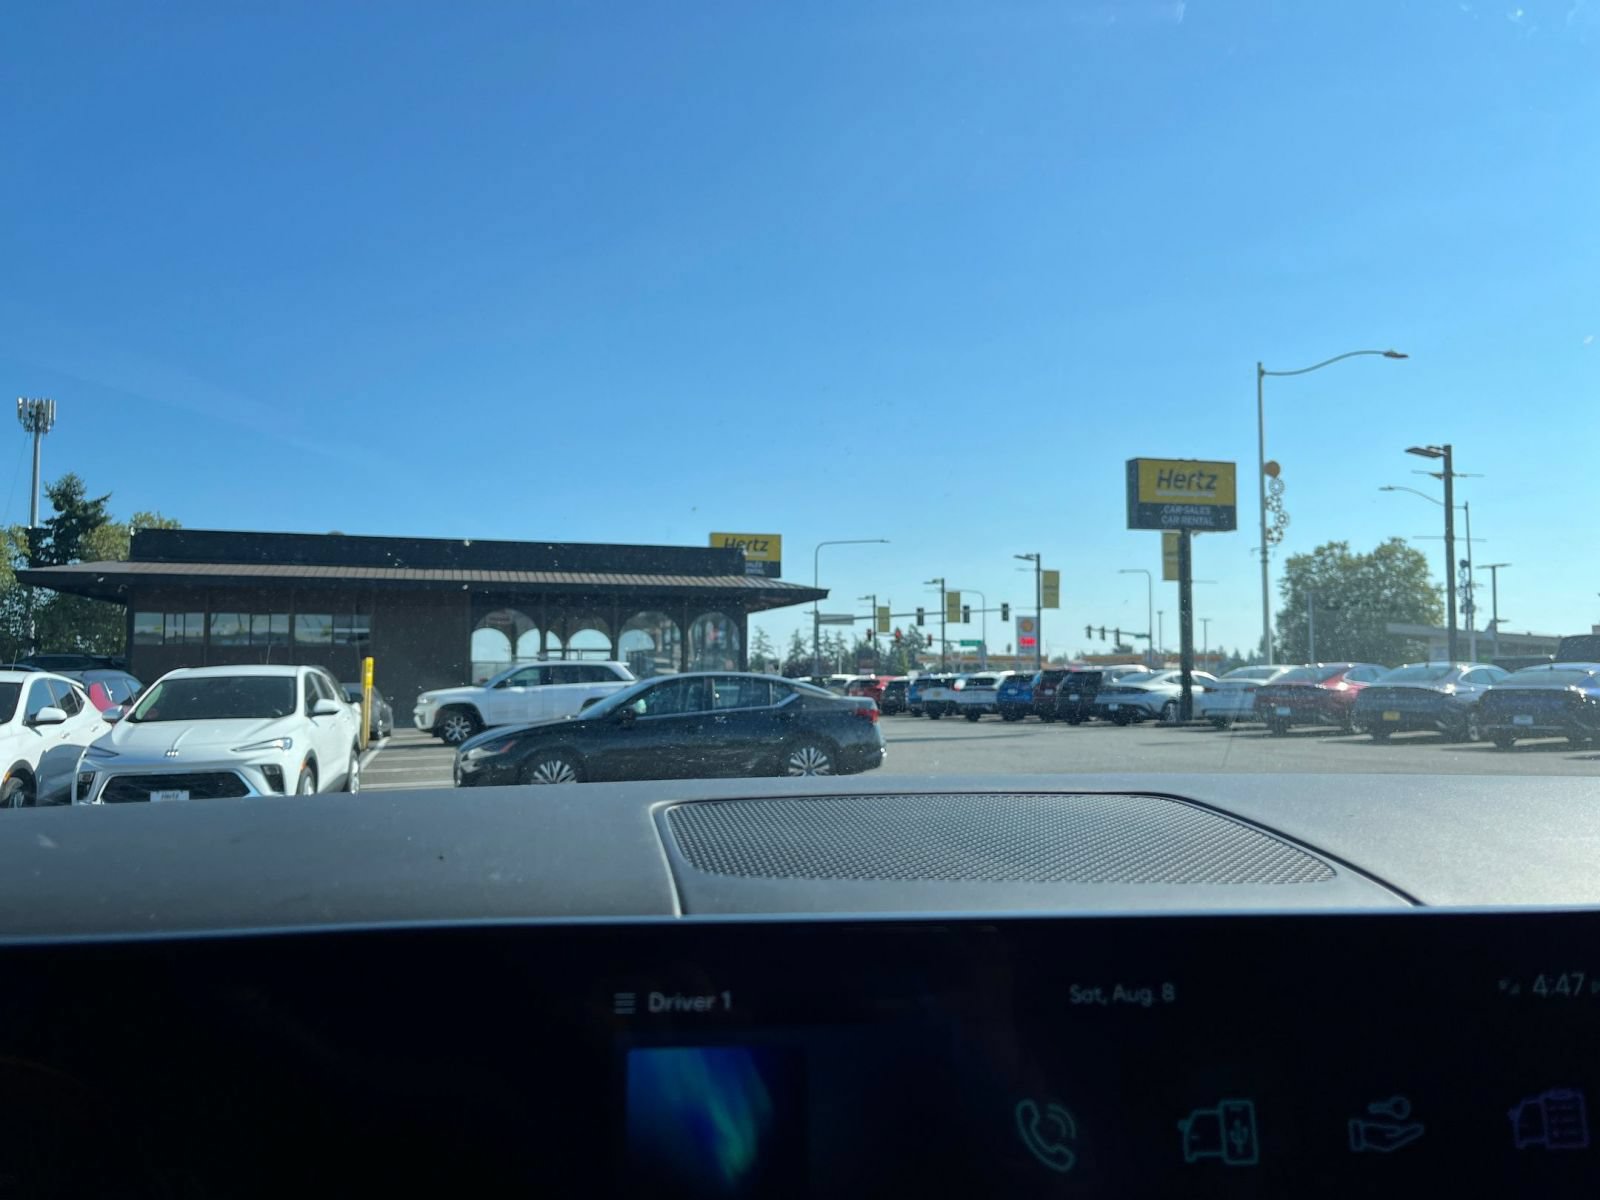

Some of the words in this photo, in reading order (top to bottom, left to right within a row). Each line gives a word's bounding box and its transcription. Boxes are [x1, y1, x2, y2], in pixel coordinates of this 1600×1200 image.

[1157, 468, 1217, 490] Hertz
[1160, 514, 1180, 524] CAR
[1181, 515, 1215, 526] RENTAL
[724, 536, 769, 552] Hertz
[1069, 983, 1108, 1007] Sat,
[1161, 981, 1176, 1003] 8
[1532, 971, 1585, 997] 4:47
[647, 991, 717, 1012] Driver
[720, 990, 733, 1011] 1
